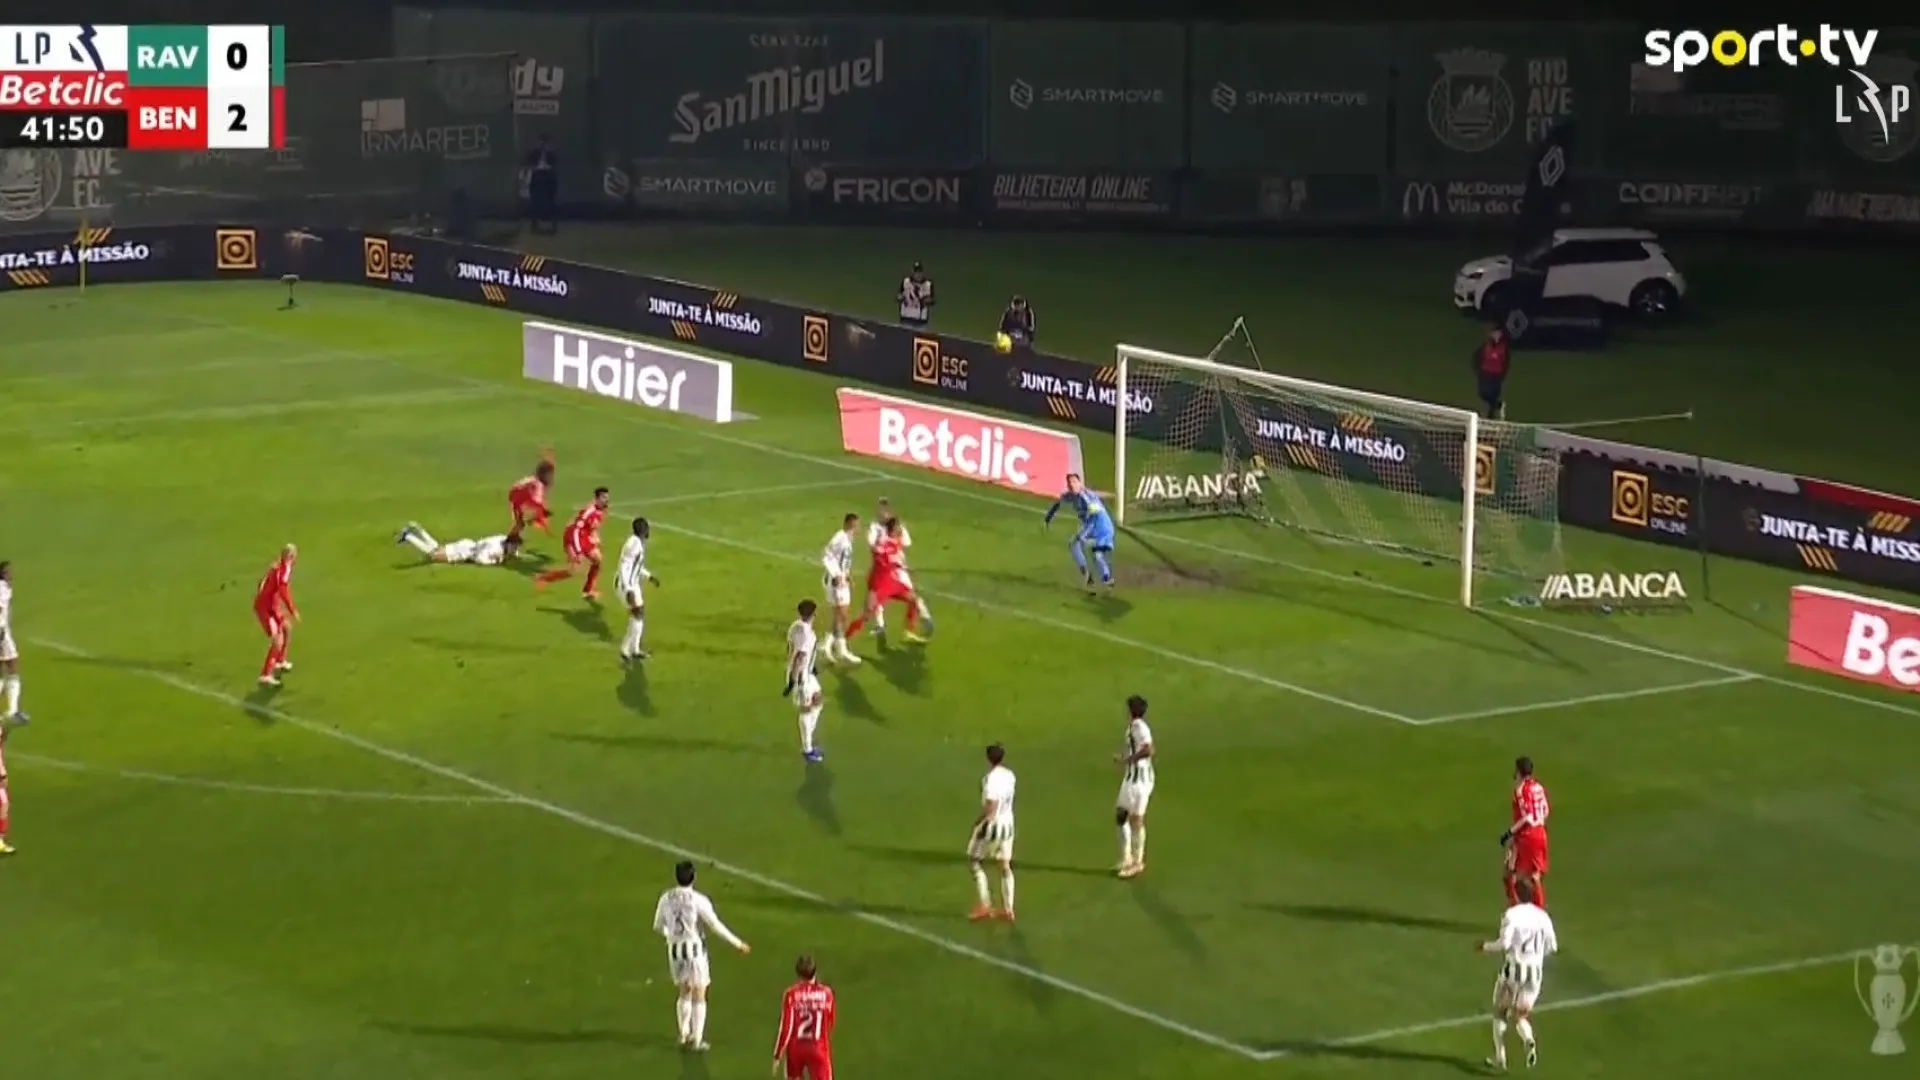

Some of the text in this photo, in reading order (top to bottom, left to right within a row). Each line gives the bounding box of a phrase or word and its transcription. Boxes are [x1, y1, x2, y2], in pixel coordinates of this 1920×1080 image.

[1041, 87, 1164, 103] SMARTMOVE
[1245, 91, 1367, 106] SMARTMOVE
[1527, 87, 1572, 114] AVE
[73, 149, 122, 177] AVE
[638, 176, 777, 195] SMARTMOVE
[832, 177, 960, 204] FRICON
[993, 174, 1153, 201] BILHETEIRA ONLINE
[1511, 198, 1525, 214] C
[60, 244, 74, 264] À
[78, 241, 149, 263] MISSÃO
[390, 253, 414, 270] ESC
[457, 262, 568, 297] JUNTA-TE À MISSÃO
[648, 297, 761, 334] JUNTA-TE À MISSÃO
[553, 335, 687, 411] Haier
[941, 356, 968, 377] ESC
[1020, 371, 1153, 414] JUNTA-TE À MISÃO
[879, 407, 1031, 485] Betclic
[1256, 418, 1405, 462] JUNTA-TE À MISSÃO
[1652, 493, 1689, 518] ESC
[1759, 513, 1850, 549] JUNTA-TE
[1852, 526, 1867, 552] À
[1842, 610, 1920, 686] Be
[797, 1011, 823, 1041] 21
